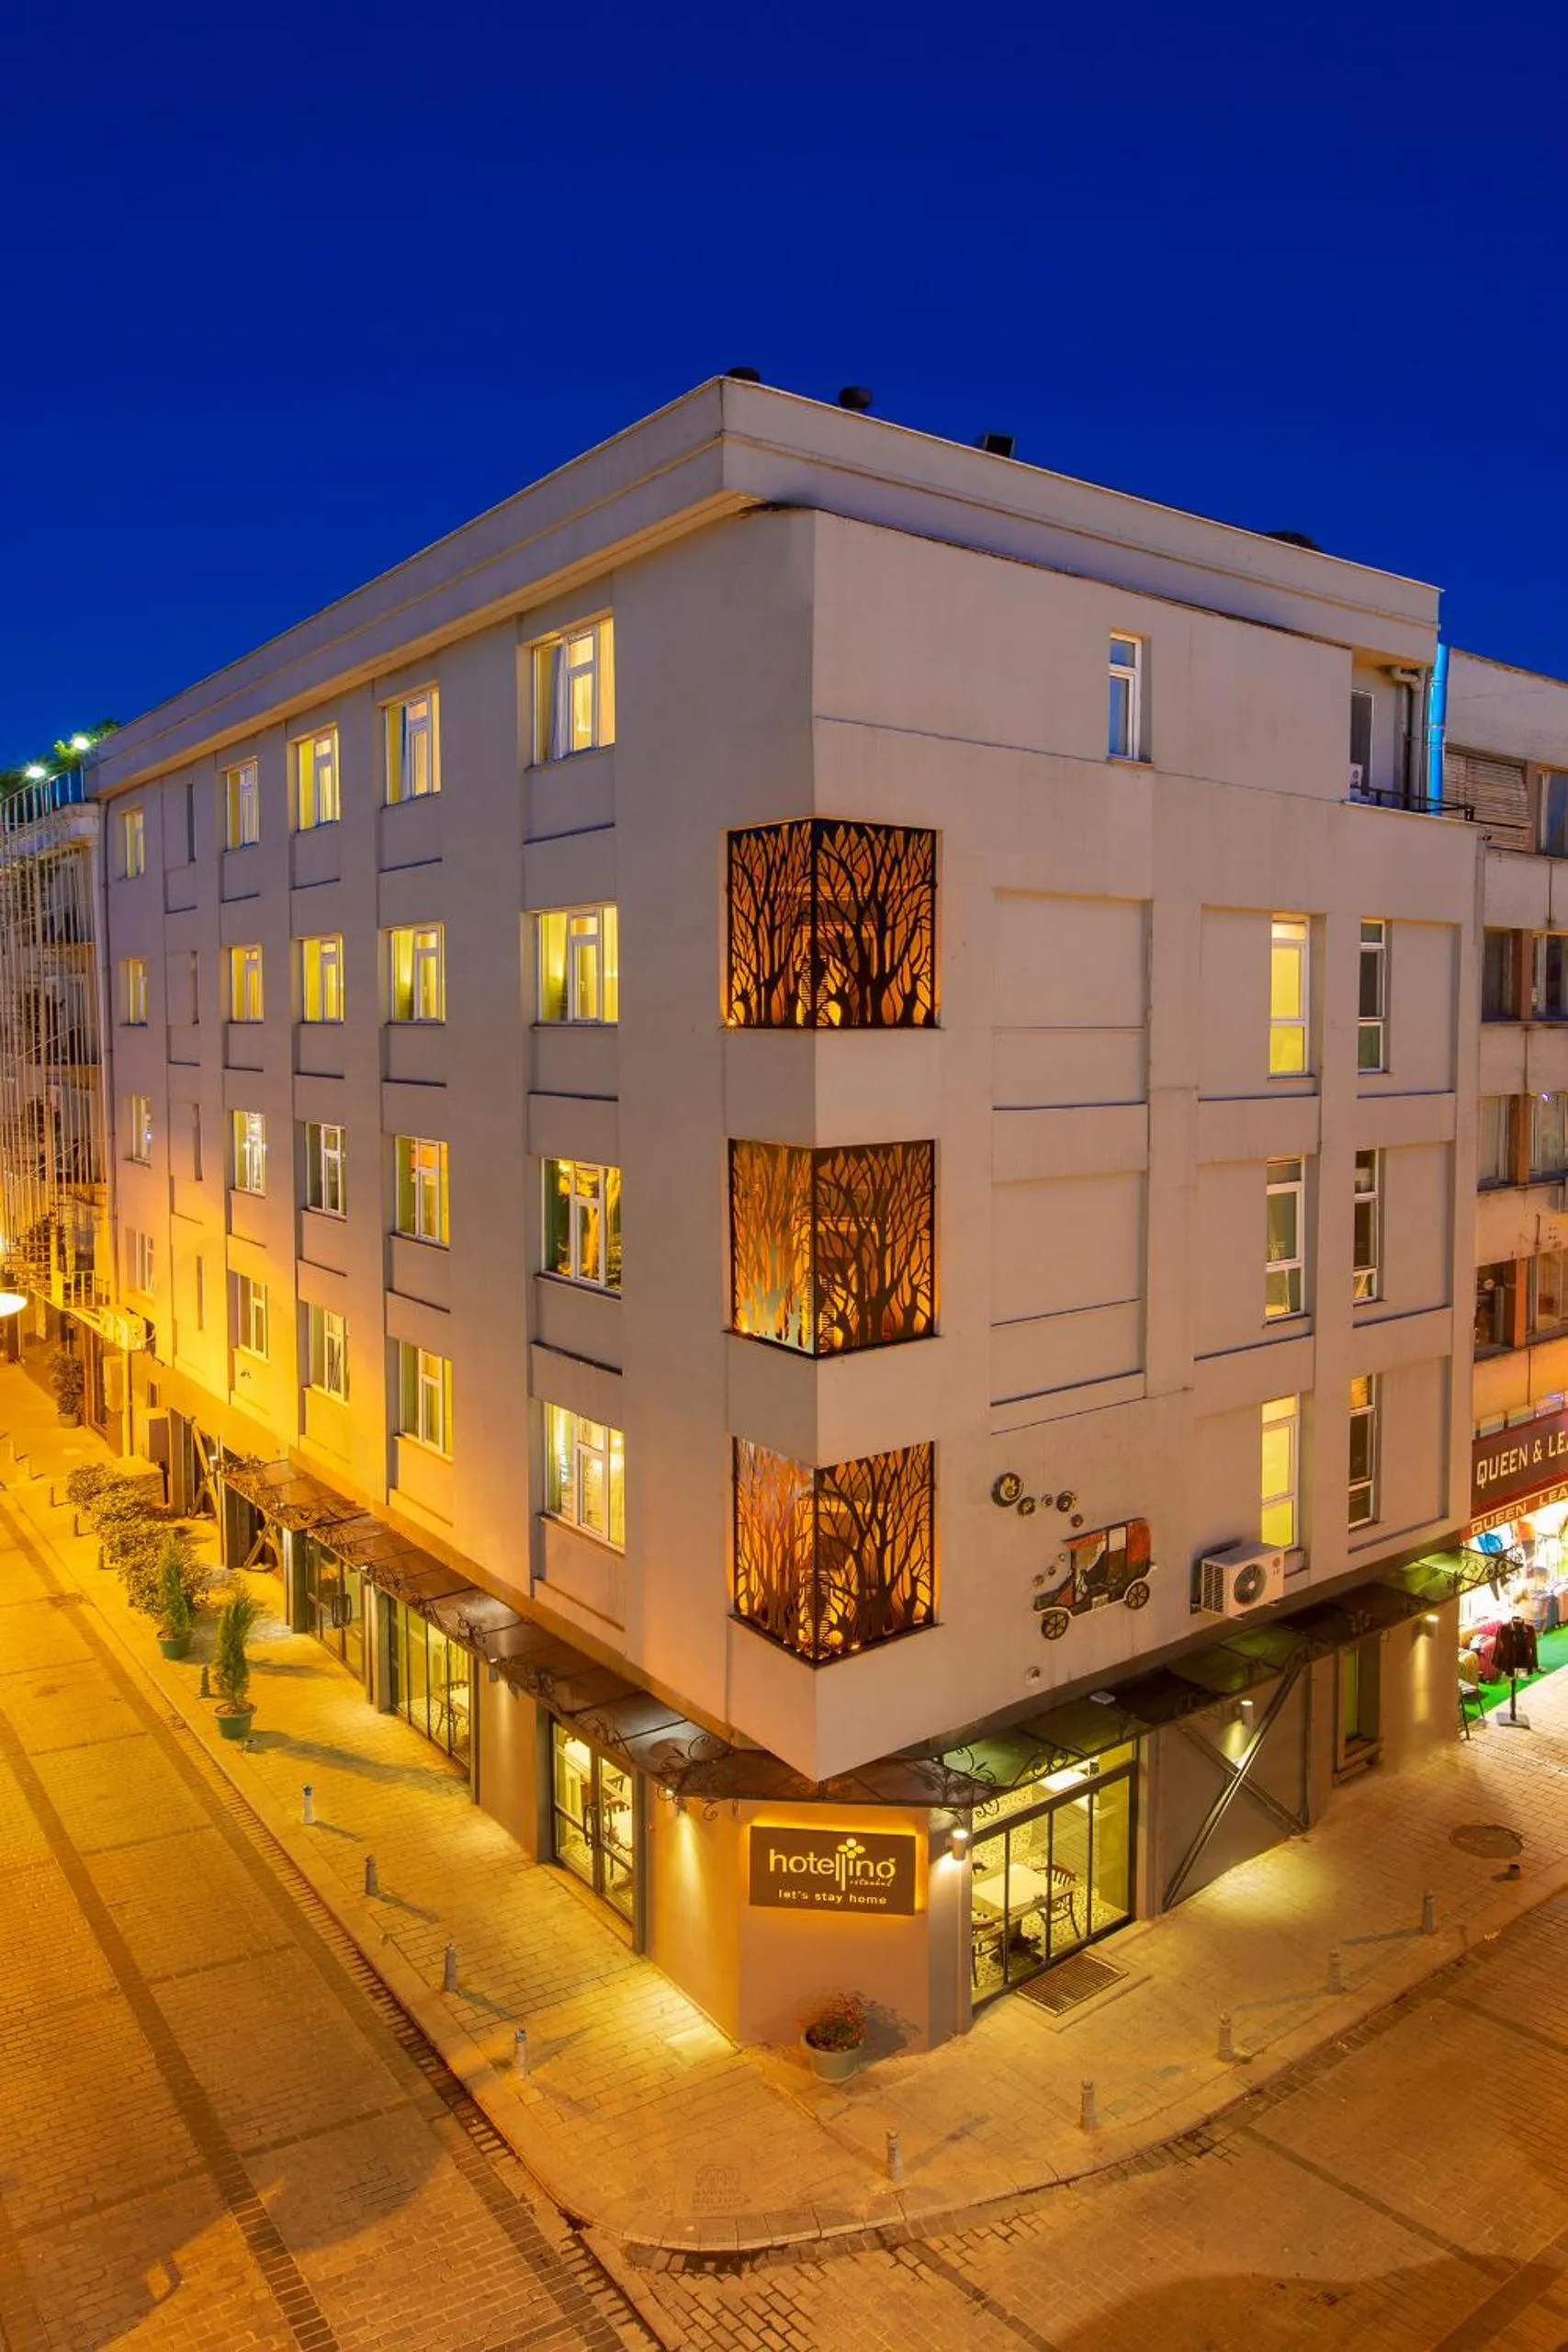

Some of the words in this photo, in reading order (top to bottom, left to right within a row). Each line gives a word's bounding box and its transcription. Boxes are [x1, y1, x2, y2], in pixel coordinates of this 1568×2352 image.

[1476, 1443, 1529, 1489] QUEEN
[1533, 1439, 1542, 1464] &
[1549, 1430, 1568, 1457] LE
[1472, 1501, 1527, 1535] QUEEN
[769, 1849, 896, 1891] hotellino
[778, 1889, 808, 1900] let's
[815, 1893, 843, 1905] stay
[849, 1894, 887, 1905] home
